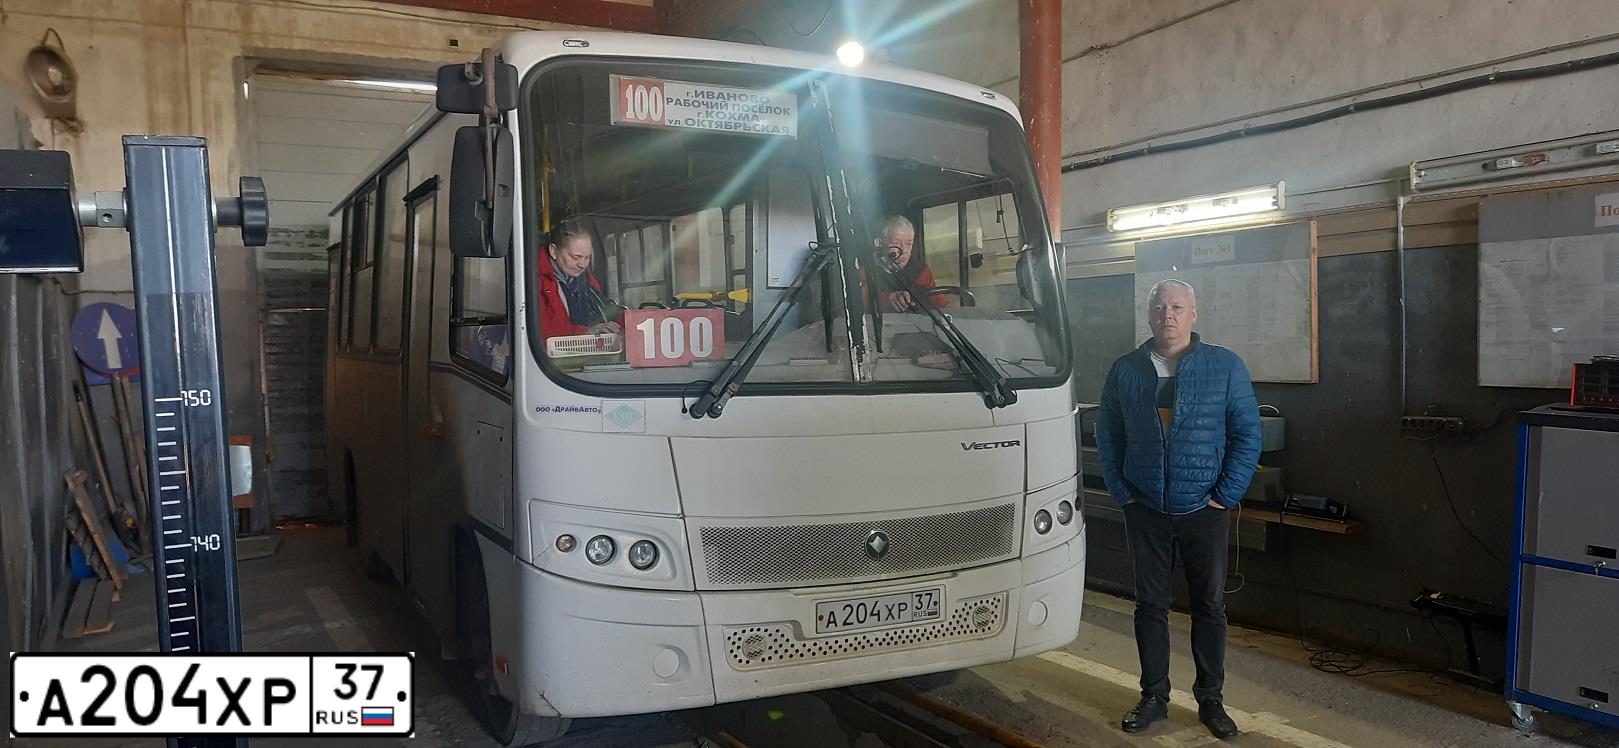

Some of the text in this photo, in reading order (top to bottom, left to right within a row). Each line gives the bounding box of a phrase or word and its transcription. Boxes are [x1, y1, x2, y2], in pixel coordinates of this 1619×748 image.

[625, 84, 664, 122] 100
[686, 89, 770, 104] г.ИВАНОВО
[665, 96, 791, 116] РАБОЧИЙ ПОСЁЛОК
[697, 110, 760, 122] г.КОХМА
[667, 117, 790, 134] ул.ОКТЯБРЬСКАЯ
[636, 316, 714, 359] 100
[180, 389, 212, 407] 150
[190, 534, 221, 552] 140
[915, 593, 933, 611] 37
